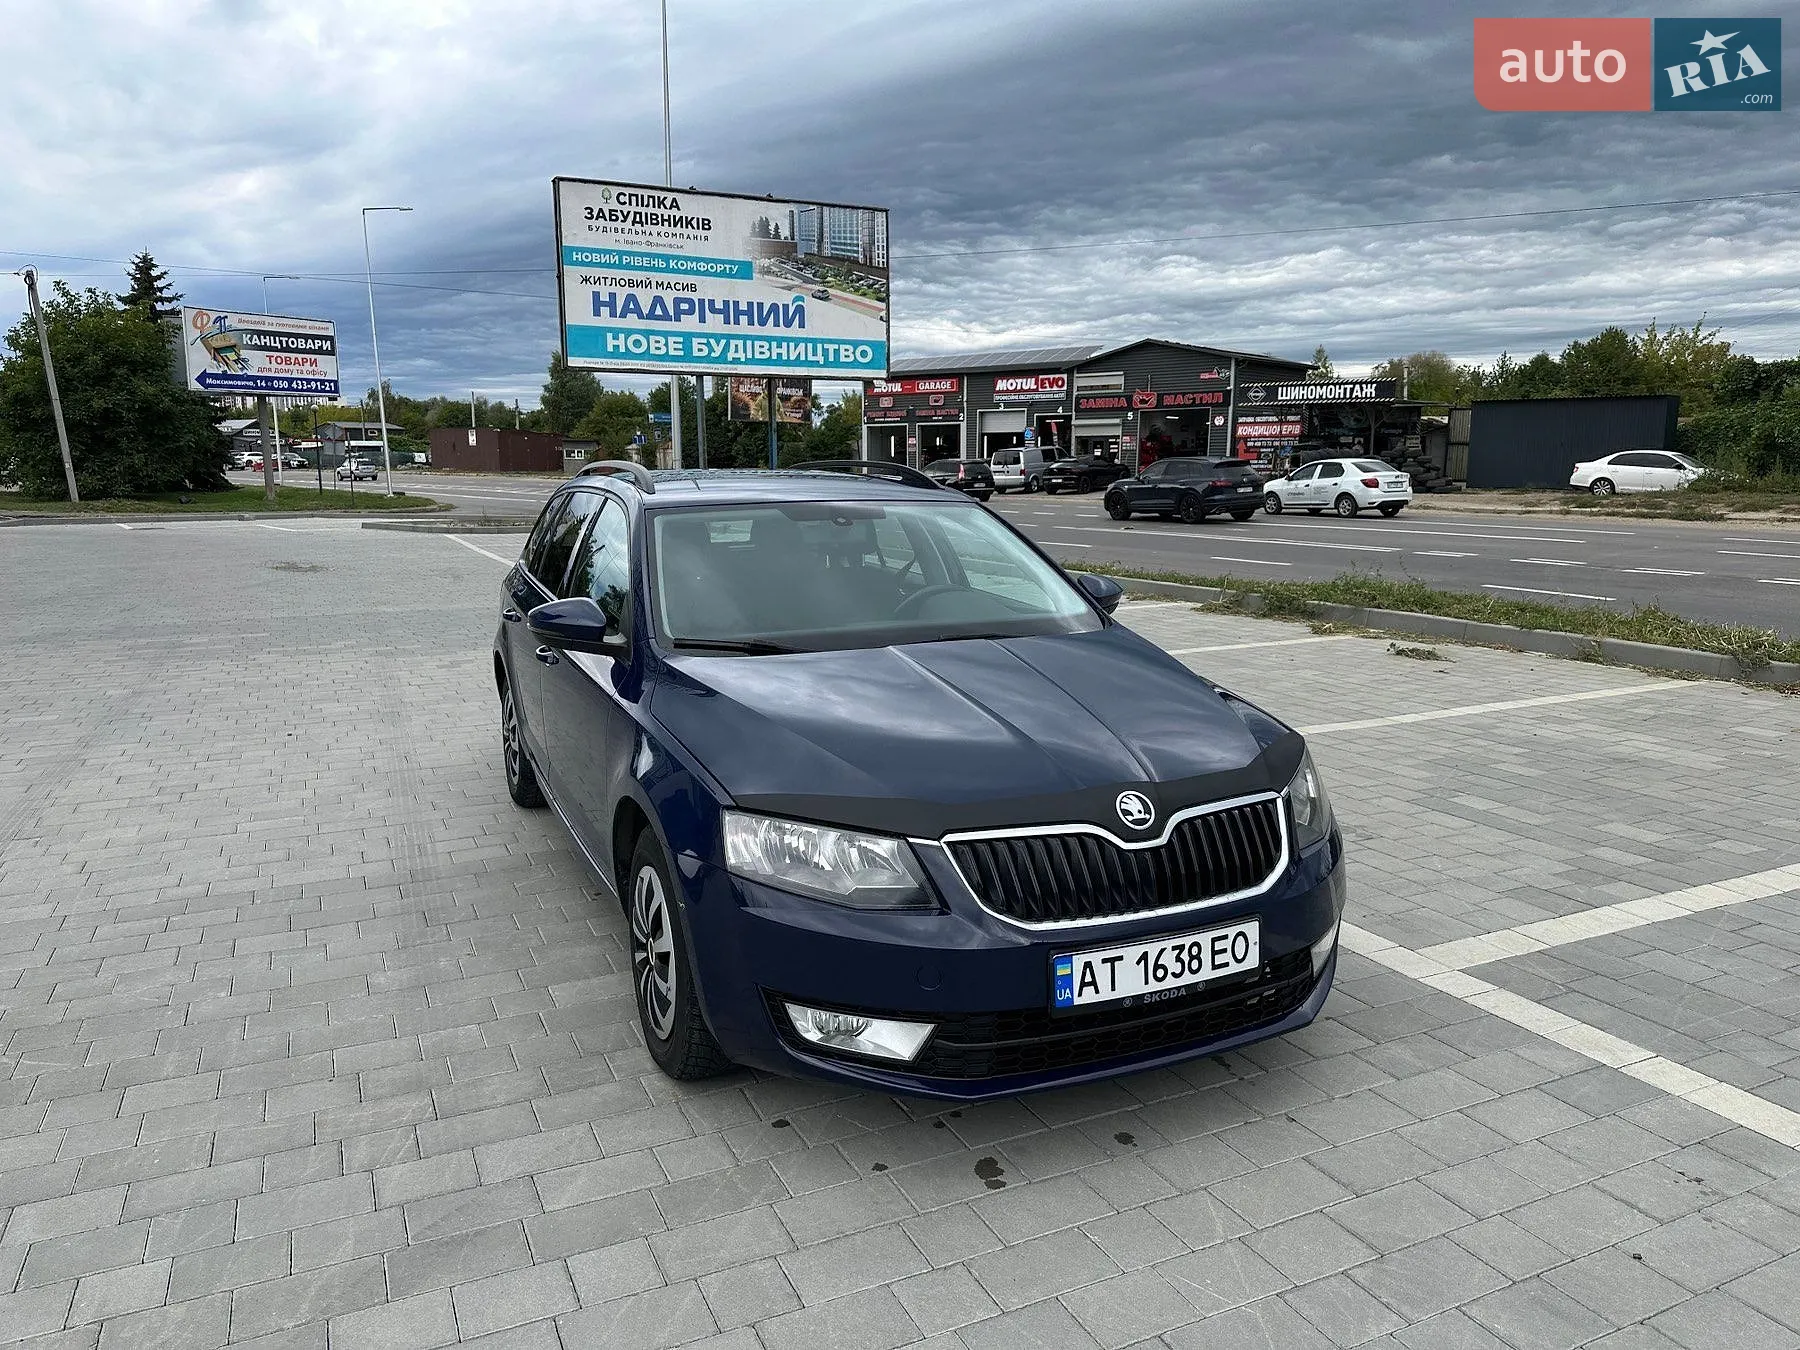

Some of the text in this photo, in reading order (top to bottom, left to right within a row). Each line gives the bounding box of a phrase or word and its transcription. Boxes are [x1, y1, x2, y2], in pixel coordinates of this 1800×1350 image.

[615, 191, 681, 211] СПІЛКА
[583, 206, 712, 231] ЗАБУДІВНИКІВ
[588, 224, 709, 242] БУДІВЕЛЬНА КОМПАНІЯ
[572, 251, 738, 274] НОВИЙ РІВЕНЬ КОМФОРТУ
[579, 274, 697, 293] ЖИТЛОВИЙ МАСИВ
[592, 290, 806, 329] НАДРІЧНИЙ
[242, 333, 331, 351] КАНЦТОВАРИ
[606, 333, 873, 365] НОВЕ БУДІВНИЦТВО
[266, 355, 318, 367] ТОВАРИ
[257, 366, 272, 374] для
[274, 367, 293, 376] дому
[305, 368, 328, 378] офісу
[257, 380, 266, 388] 14
[273, 380, 288, 389] 050
[291, 381, 335, 391] 433-91-21
[918, 381, 952, 390] GARAGE
[995, 376, 1066, 391] MOTUL EVO
[1277, 383, 1377, 400] ШИНОМОНТАЖ
[1079, 393, 1223, 409] ЗАМІНА МАСТИЛ
[1127, 411, 1134, 420] 5
[1056, 930, 1249, 1000] UA AT 1638 EO
